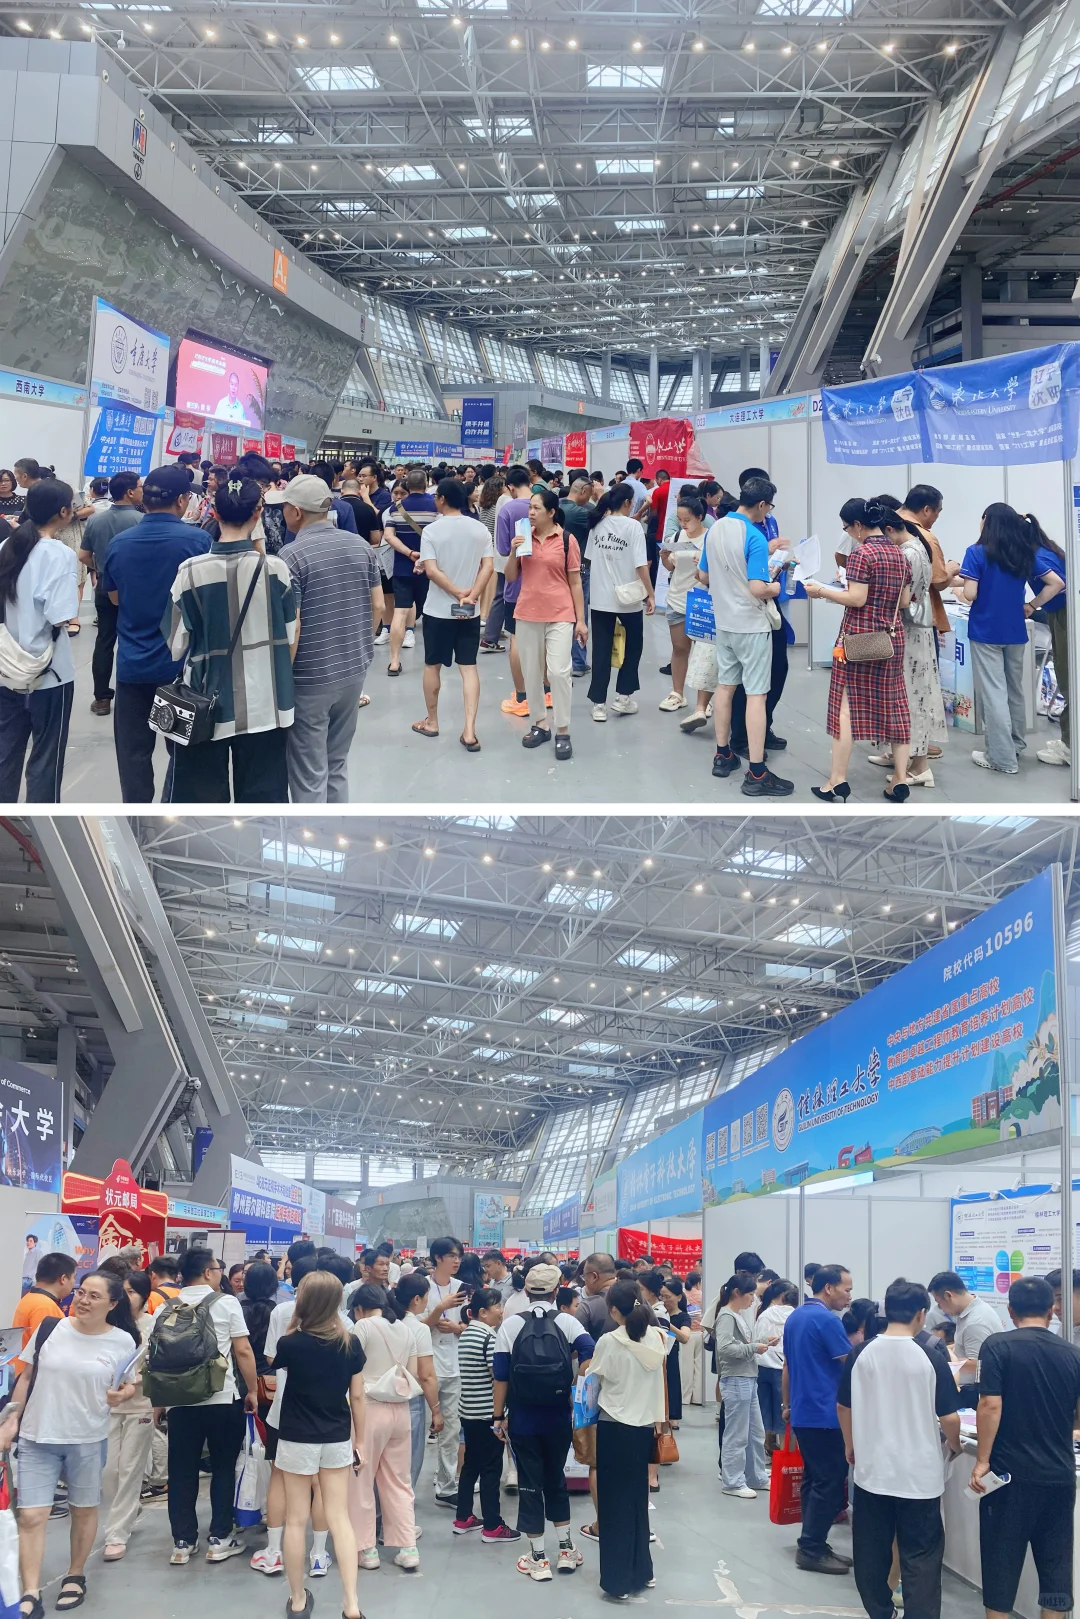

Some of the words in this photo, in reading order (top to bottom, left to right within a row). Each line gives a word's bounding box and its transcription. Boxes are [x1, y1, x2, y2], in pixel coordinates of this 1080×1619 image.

[16, 379, 45, 397] 西南大学
[729, 408, 765, 424] 大连理工大学
[887, 976, 1000, 1047] 中央与地方共建省属重点高校
[887, 987, 1035, 1070] 教育部卓越工程师教育培养计划高校
[887, 1021, 1024, 1092] 中西部基础能力提升计划建设高校
[6, 1080, 31, 1095] Commerce
[0, 1100, 54, 1141] 大学
[811, 1110, 837, 1127] UNIVERSITY
[836, 1107, 844, 1118] OF
[843, 1092, 879, 1115] TECHNOLOGY
[105, 1188, 138, 1209] 状元邮局
[75, 1246, 96, 1257] Why
